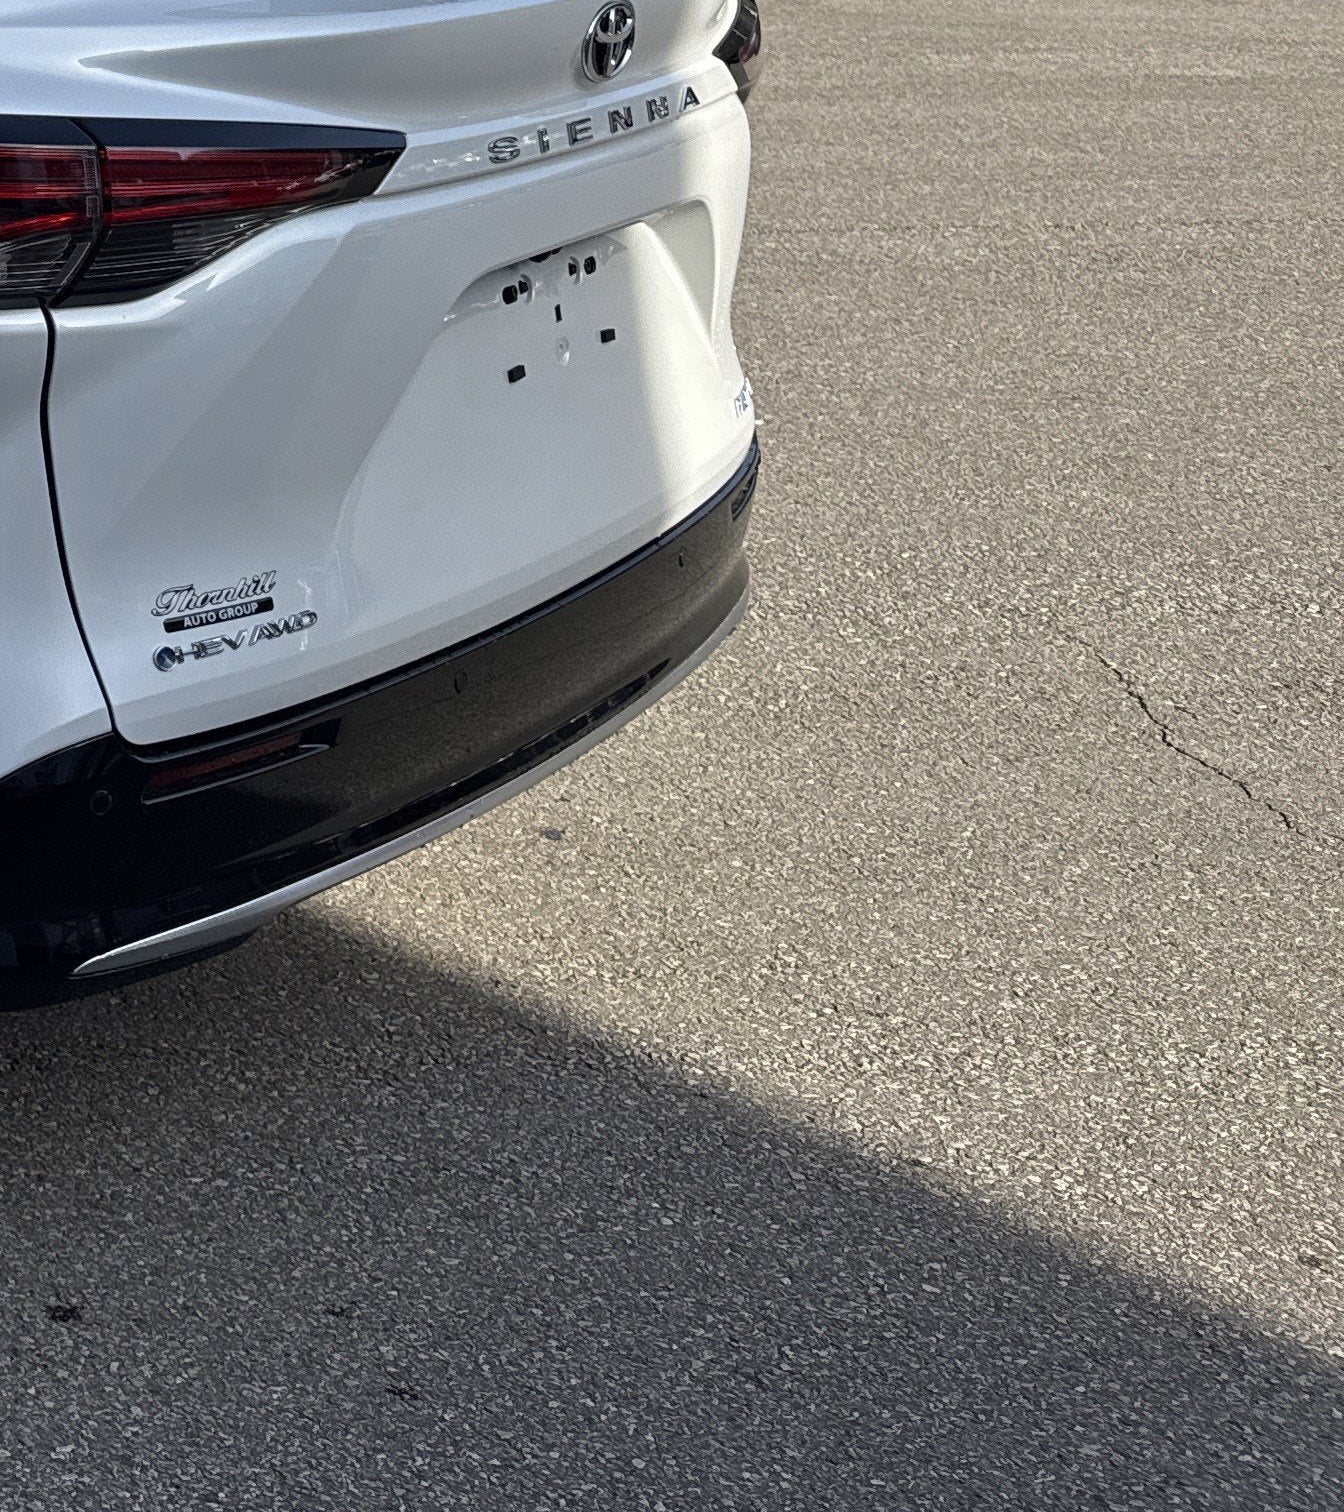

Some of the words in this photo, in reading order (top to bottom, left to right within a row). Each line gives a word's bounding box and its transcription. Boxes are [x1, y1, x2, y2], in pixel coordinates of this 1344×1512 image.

[487, 86, 701, 164] SIENNA
[150, 569, 277, 617] Thornhill
[183, 611, 217, 629] AUTO
[218, 601, 259, 620] GROUP
